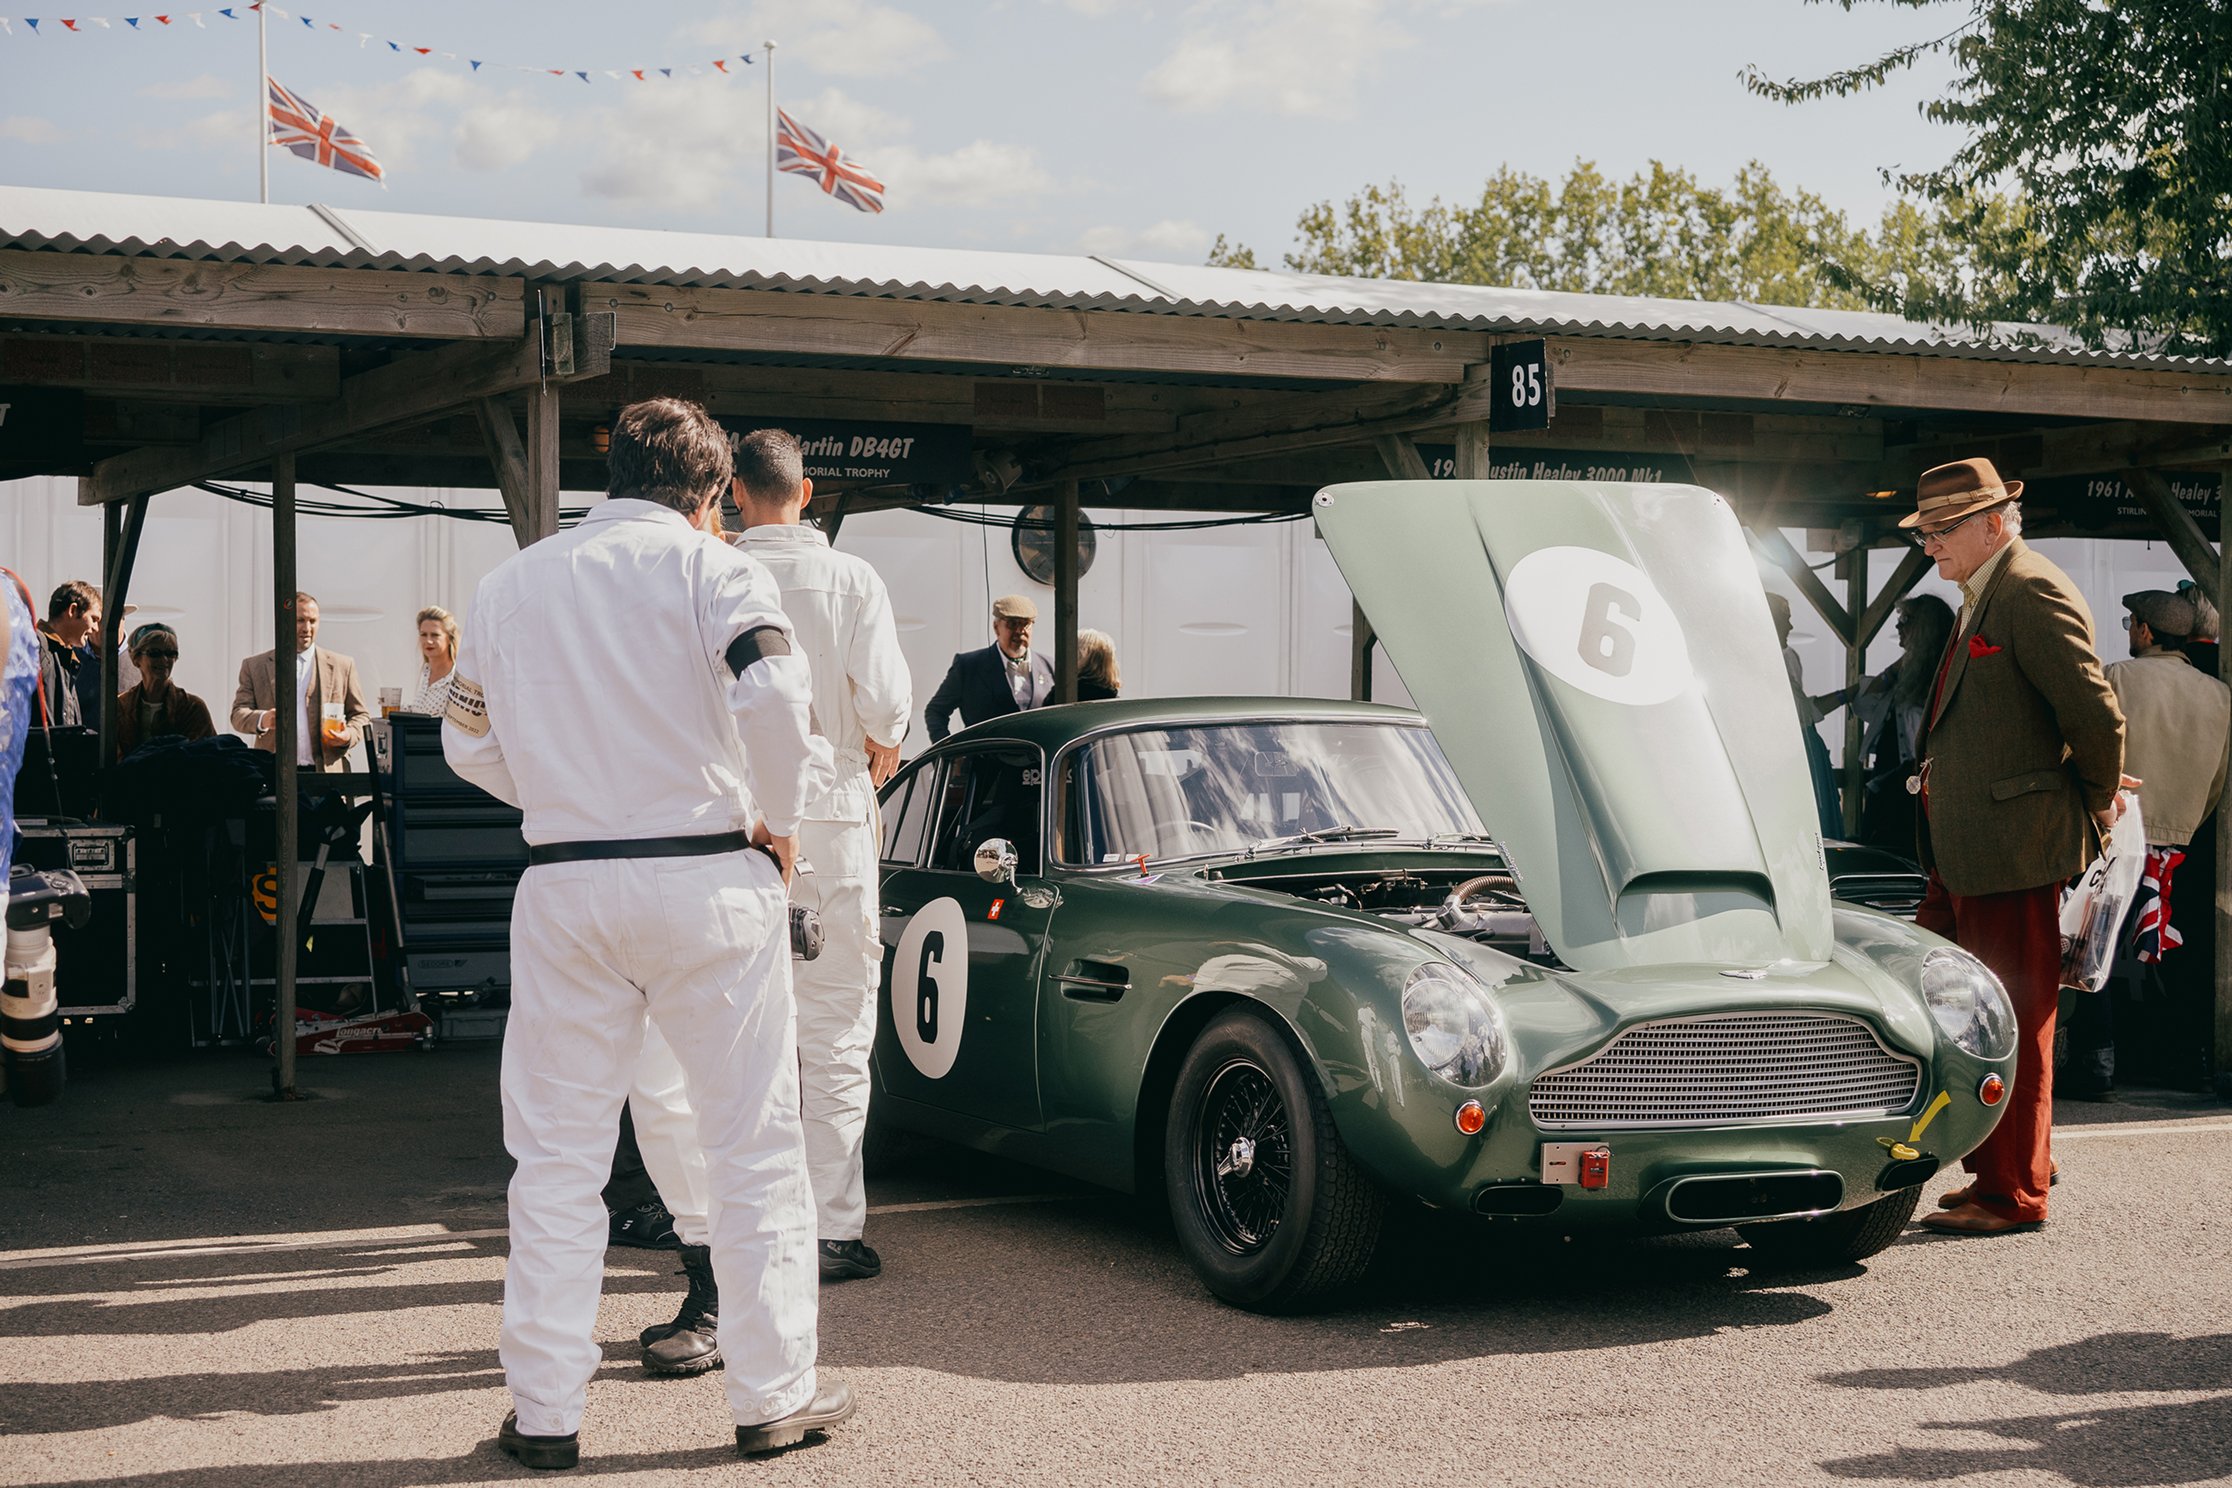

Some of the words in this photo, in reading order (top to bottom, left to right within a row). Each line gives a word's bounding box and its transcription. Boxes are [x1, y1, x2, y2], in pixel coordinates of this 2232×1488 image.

[1511, 363, 1541, 408] 85
[796, 434, 844, 457] artin
[849, 435, 915, 459] DB4GT
[803, 466, 842, 477] ORIAL
[845, 467, 890, 478] TROPHY
[1433, 458, 1456, 478] 19
[1489, 460, 1528, 480] ustin
[1533, 462, 1581, 481] Healey
[1587, 466, 1626, 482] 3000
[1631, 467, 1663, 483] Mk1
[2087, 480, 2121, 498] 1961
[2171, 482, 2211, 505] Healey
[2117, 506, 2147, 516] STIRLIN
[2186, 509, 2217, 518] MORIAL
[1577, 582, 1642, 677] 6
[917, 930, 944, 1044] 6
